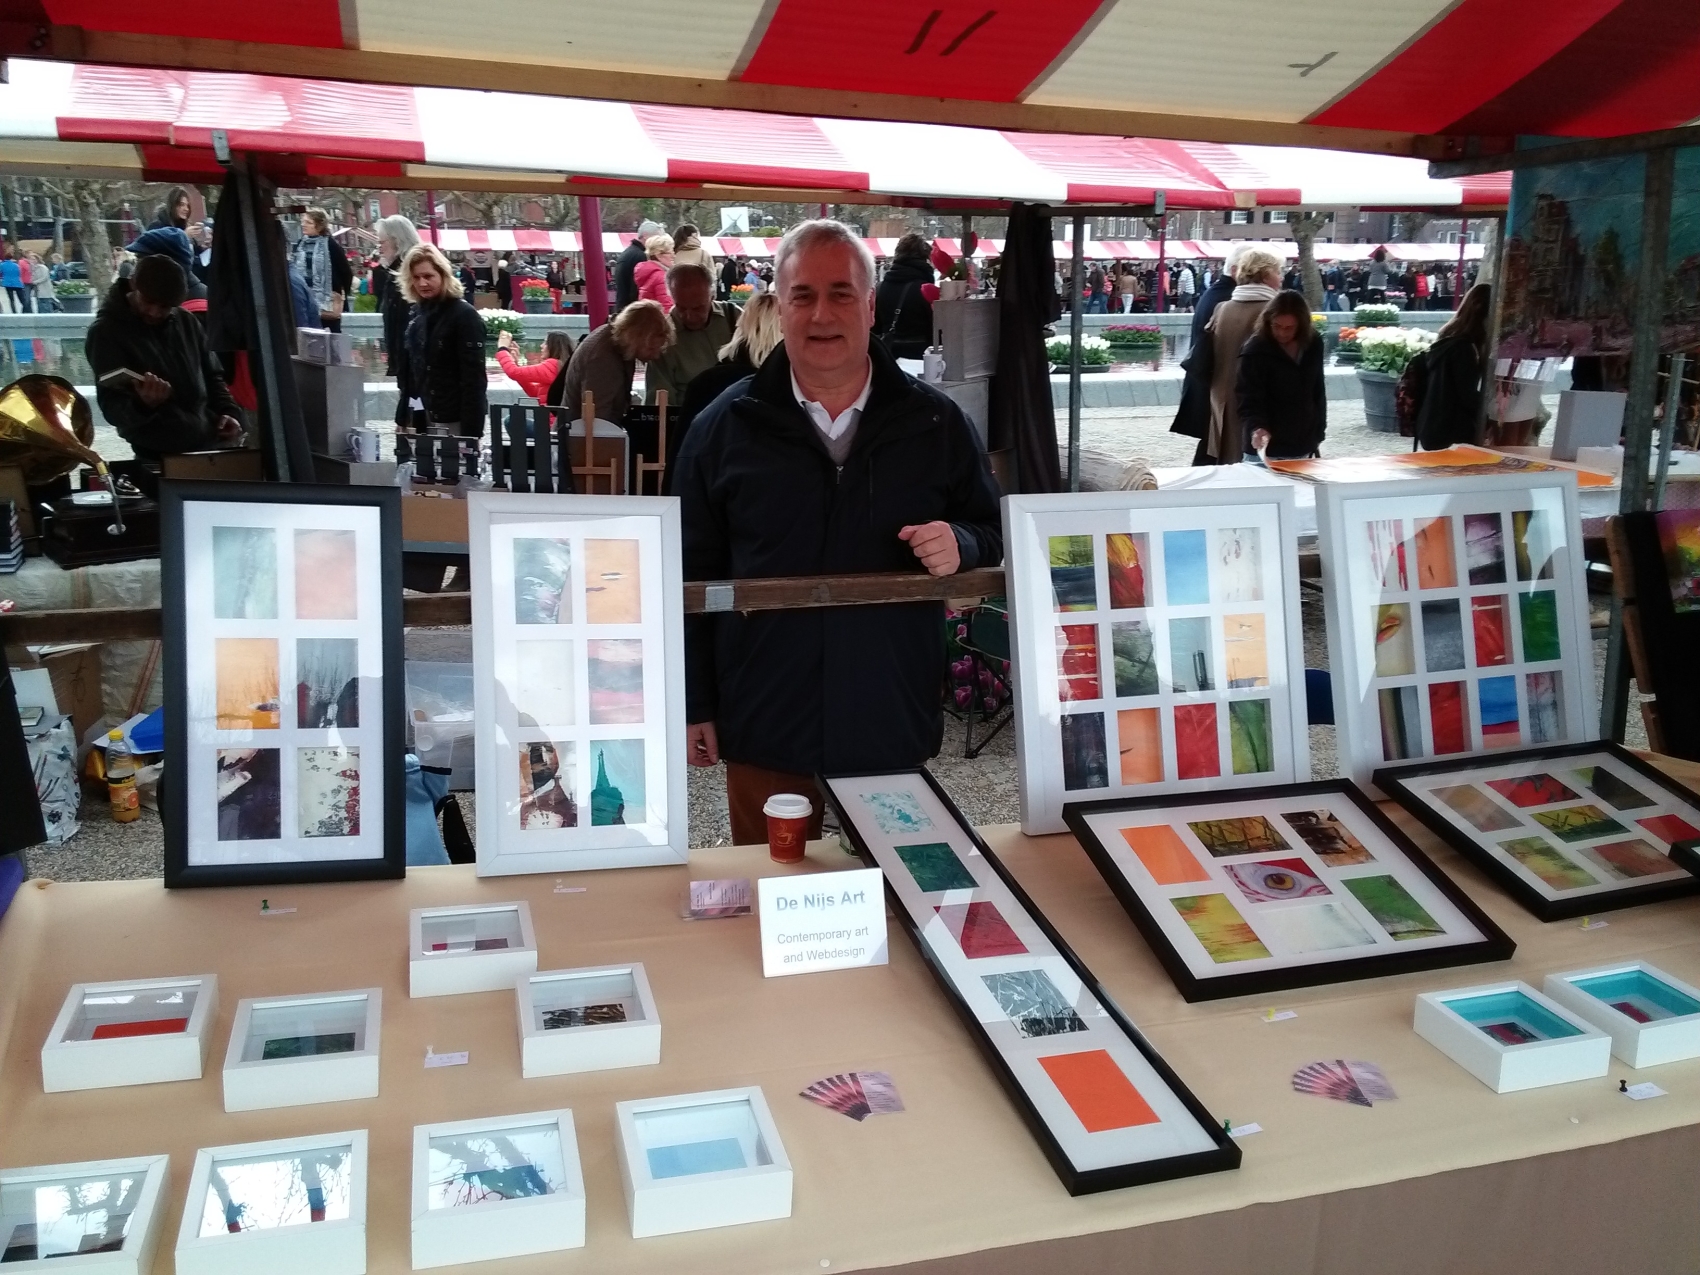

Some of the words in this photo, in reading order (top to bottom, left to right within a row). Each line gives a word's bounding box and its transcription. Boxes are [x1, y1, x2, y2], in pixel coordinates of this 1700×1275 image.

[776, 896, 799, 912] De
[803, 892, 835, 911] Nijs
[840, 890, 866, 906] Art
[777, 929, 852, 945] Contemporary
[854, 926, 869, 937] art
[783, 951, 804, 964] and
[806, 946, 866, 961] Webdesign
